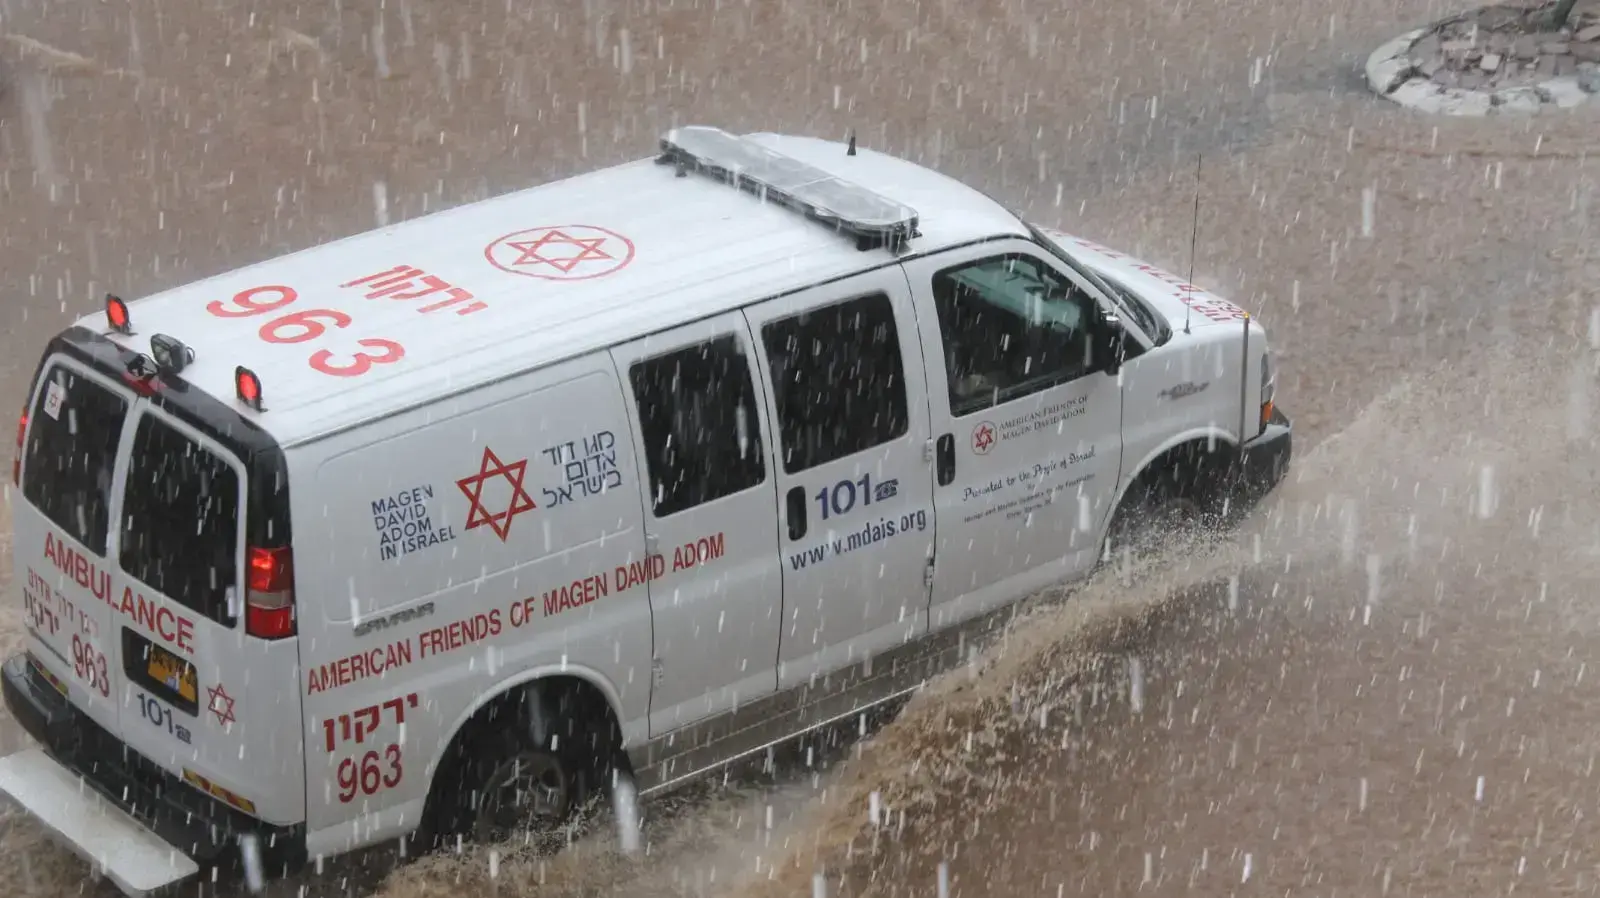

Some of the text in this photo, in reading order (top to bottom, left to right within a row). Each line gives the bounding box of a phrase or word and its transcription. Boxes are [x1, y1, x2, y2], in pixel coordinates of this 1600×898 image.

[340, 265, 488, 315] ירקון
[206, 285, 405, 376] 963
[542, 431, 615, 466] מגן דוד
[566, 449, 616, 482] אדום
[371, 484, 433, 515] MAGEN
[374, 503, 426, 531] DAVID
[815, 473, 870, 520] 101
[380, 517, 432, 545] ADOM
[380, 525, 456, 561] IN ISRAEL
[790, 510, 926, 571] www.mdais.org
[44, 532, 194, 654] AMBULANCE
[308, 532, 724, 695] AMERICAN FRIENDS OF MAGEN DAVID ADOM
[72, 633, 110, 698] 963
[137, 693, 173, 734] 101
[323, 693, 419, 753] ירקון
[337, 744, 402, 803] 963
